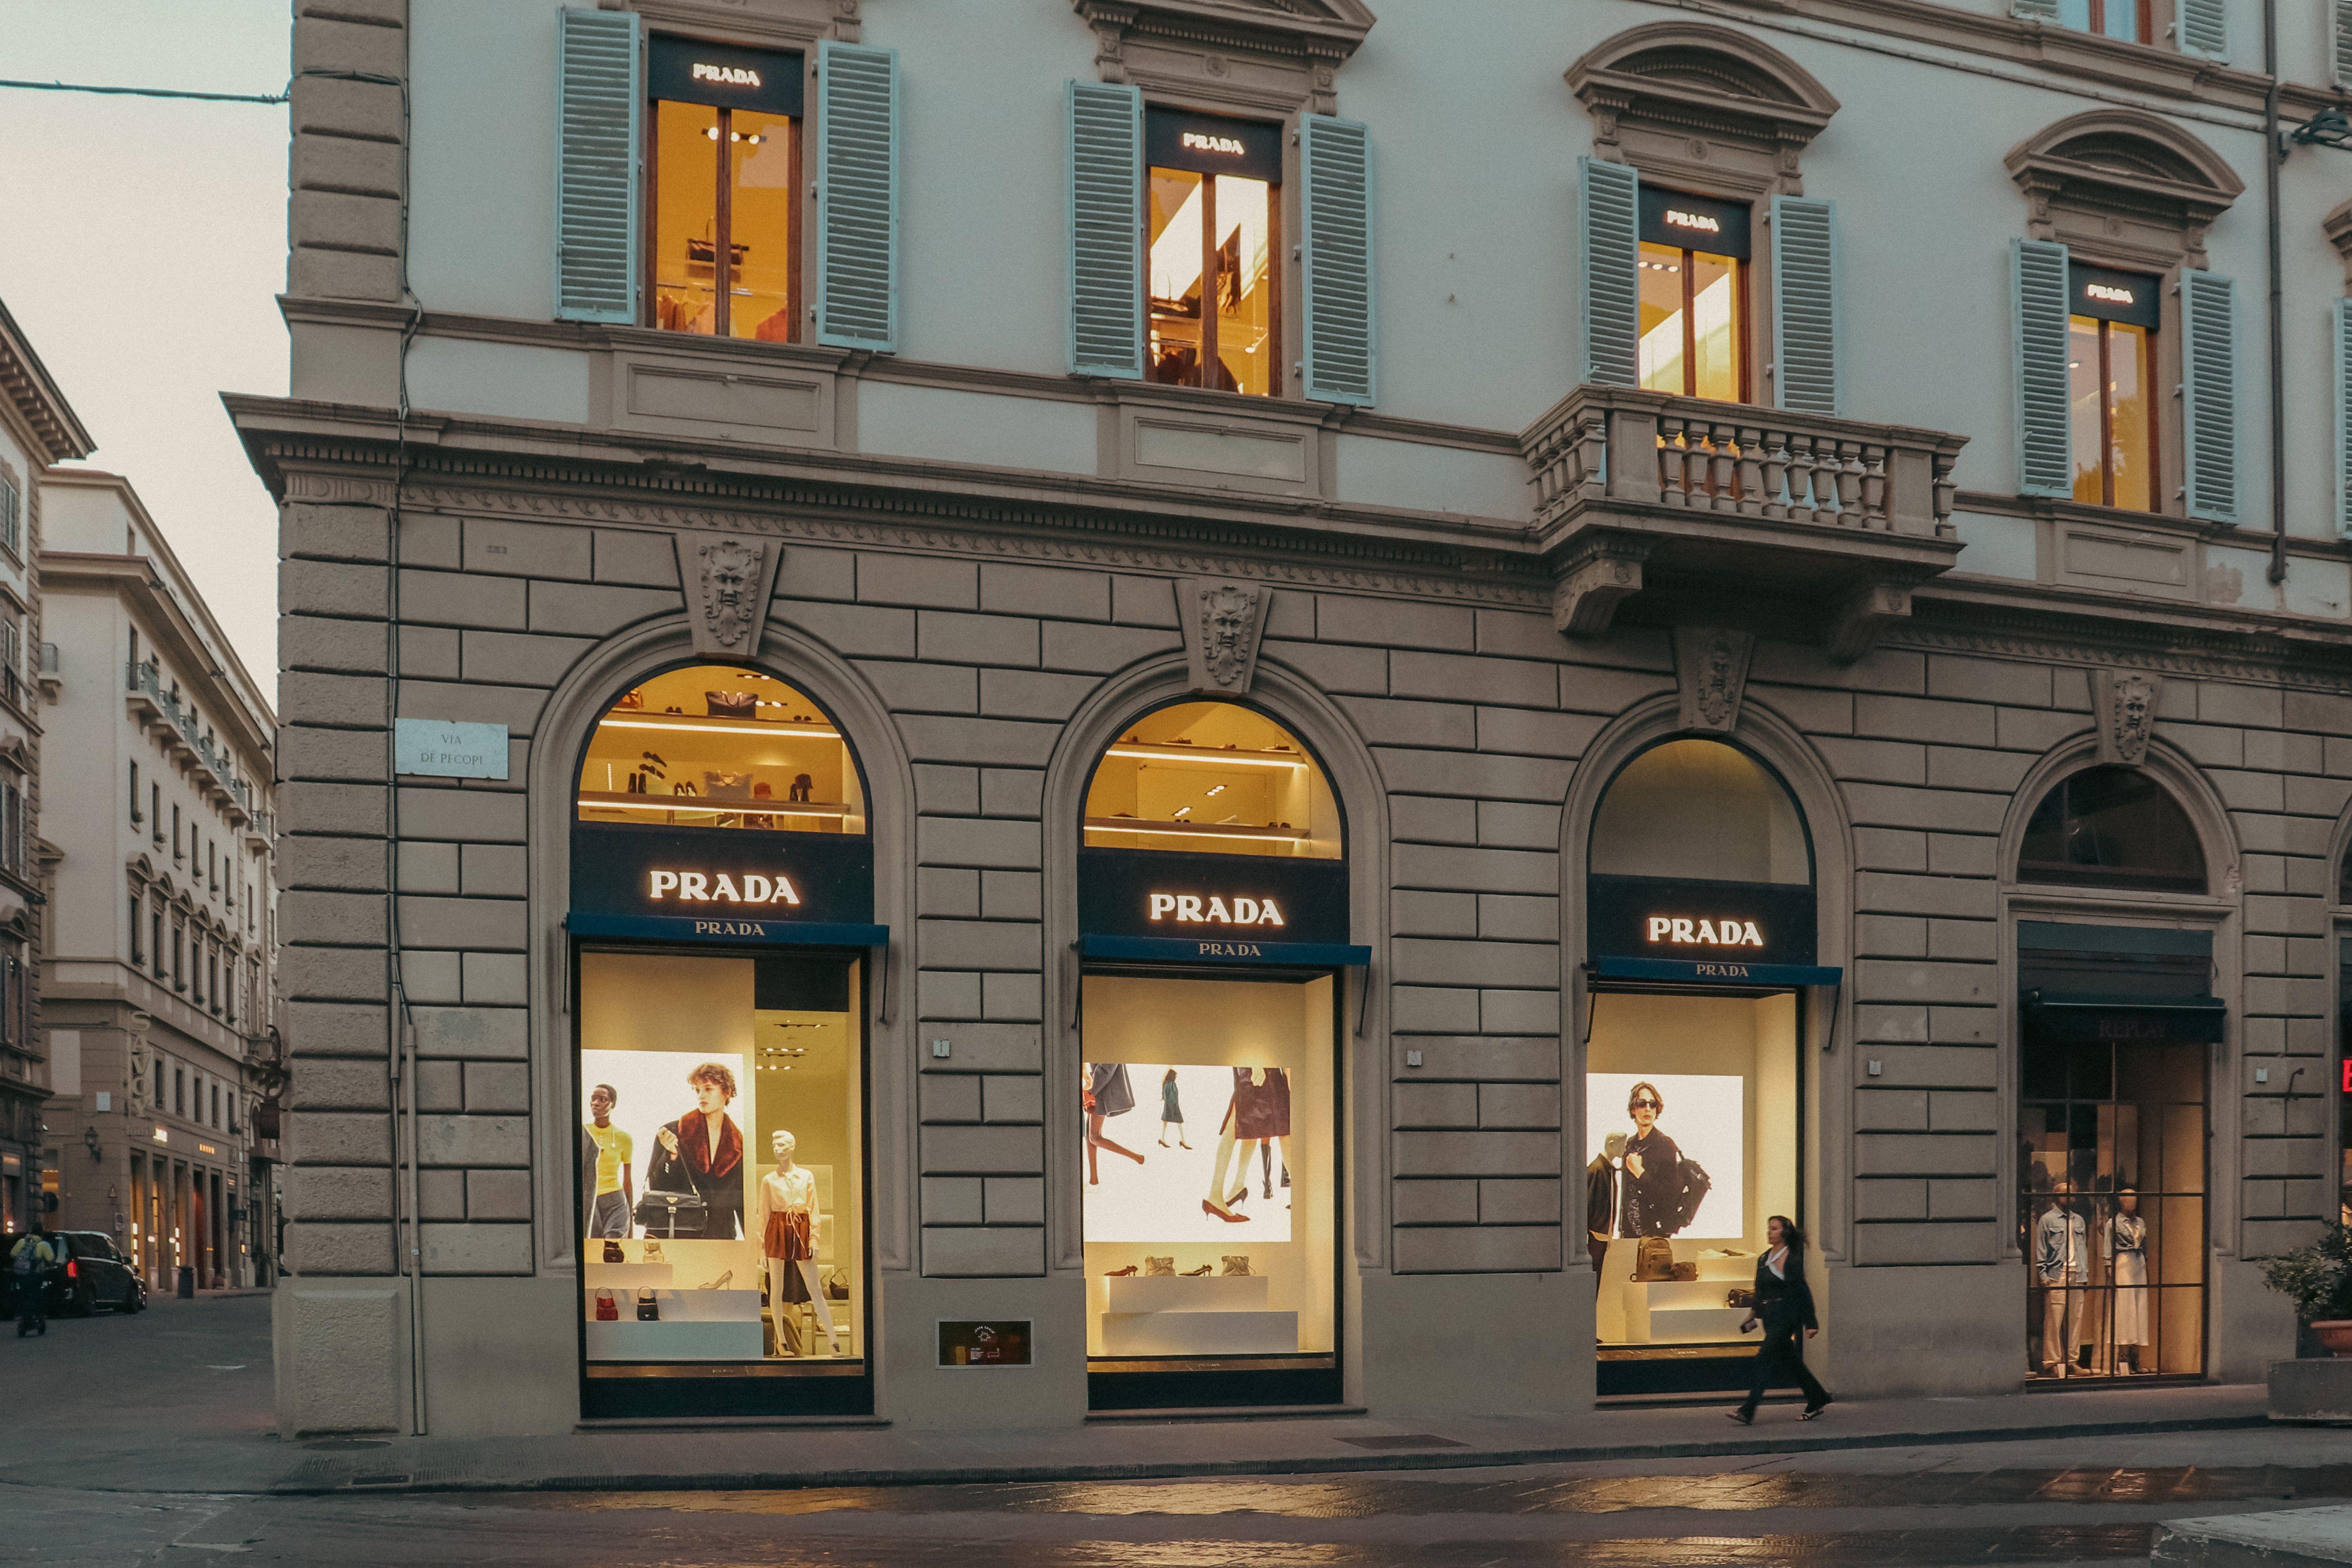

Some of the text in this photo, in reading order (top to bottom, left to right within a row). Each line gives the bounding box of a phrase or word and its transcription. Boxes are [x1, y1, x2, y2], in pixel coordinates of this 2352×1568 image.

[693, 63, 760, 86] PRADA
[1183, 132, 1245, 155] PRADA
[1667, 210, 1719, 232] PRADA
[441, 734, 461, 745] VIA
[650, 871, 800, 904] PRADA
[1150, 894, 1284, 925] PRADA
[695, 922, 765, 936] PRADA
[1649, 917, 1763, 946] PRADA
[1199, 943, 1261, 956] PRADA
[1696, 964, 1749, 977] PRADA
